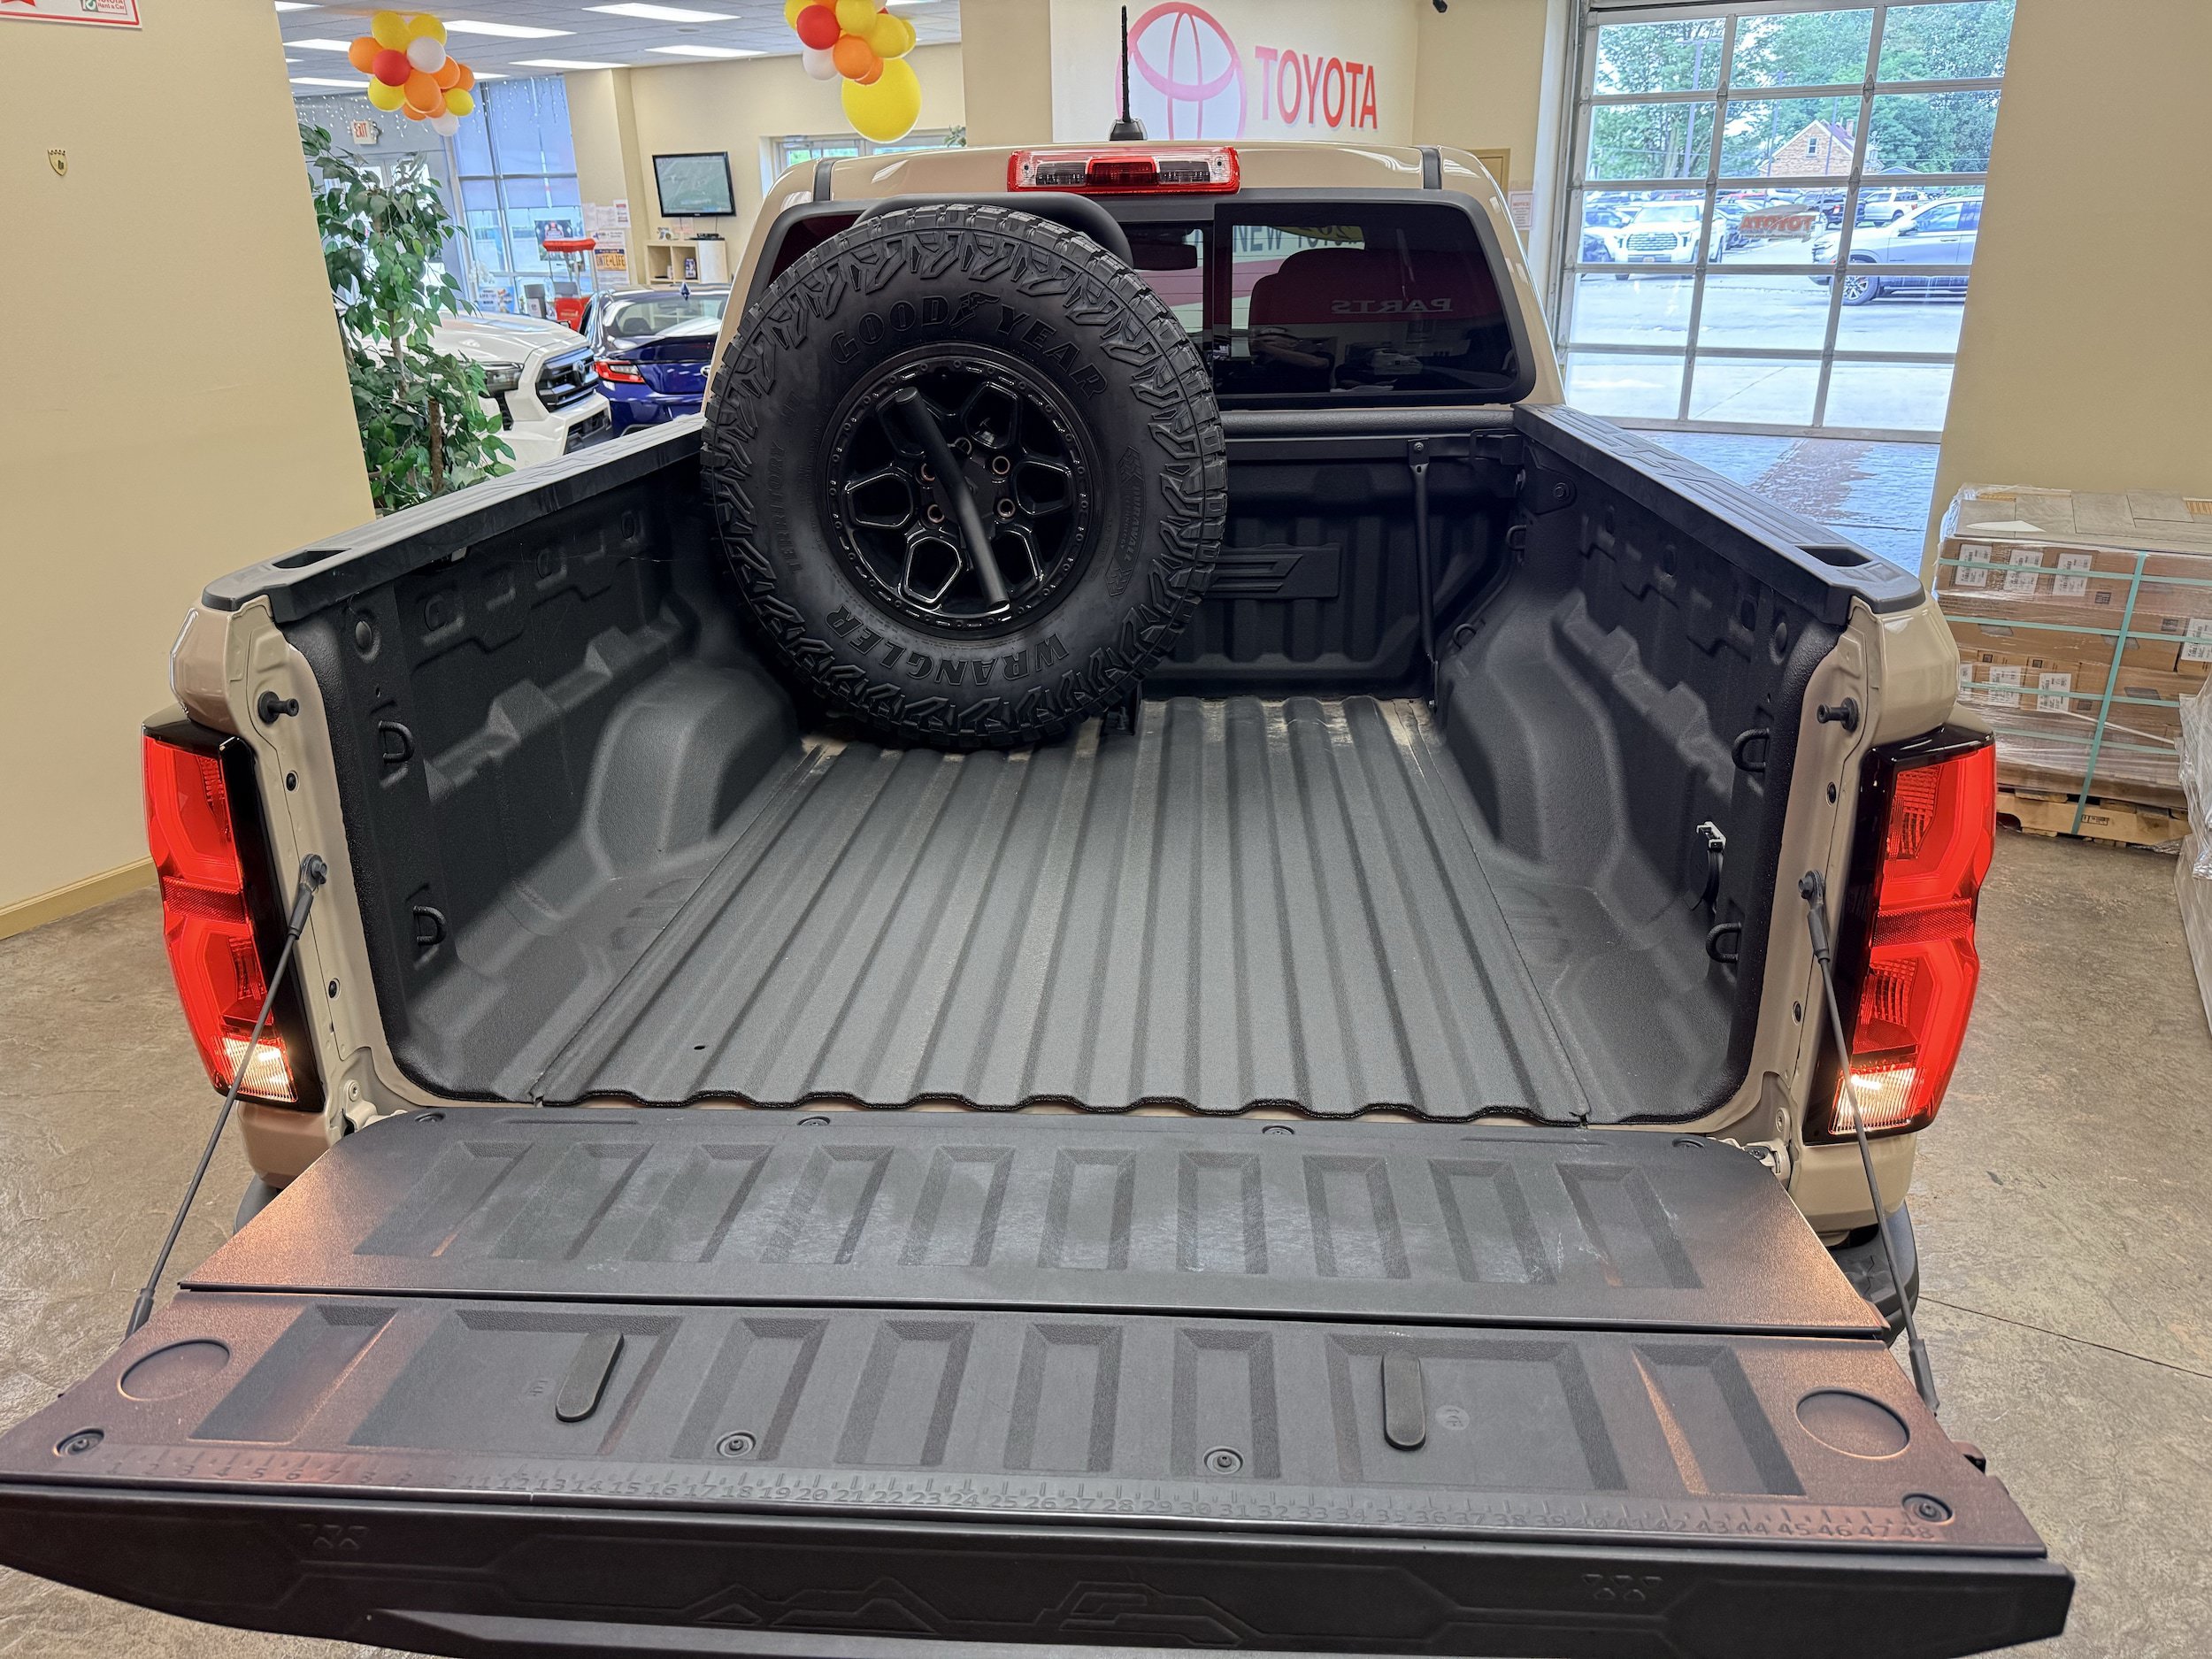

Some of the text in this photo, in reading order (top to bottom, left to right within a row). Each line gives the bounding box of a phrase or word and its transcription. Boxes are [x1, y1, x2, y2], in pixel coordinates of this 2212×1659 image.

[1255, 46, 1378, 129] TOYOTA
[354, 122, 368, 137] EXIT
[828, 295, 1108, 398] GOOD YEAR
[767, 440, 803, 574] TERRITORY
[825, 604, 1071, 687] WRANGLER
[177, 1464, 196, 1478] 3
[214, 1466, 232, 1479] 4
[248, 1467, 268, 1479] 5
[285, 1469, 303, 1481] 6
[323, 1470, 342, 1482] 7
[534, 1479, 567, 1492] 13
[571, 1479, 603, 1493] 14
[609, 1481, 641, 1494] 15
[645, 1483, 680, 1495] 16
[683, 1484, 718, 1497] 17
[721, 1485, 754, 1498] 18
[758, 1486, 792, 1500] 19
[795, 1487, 828, 1502] 20
[833, 1488, 864, 1502] 21
[870, 1490, 903, 1504] 22
[909, 1491, 941, 1505] 23
[948, 1493, 979, 1507] 24
[988, 1494, 1018, 1508] 25
[1024, 1495, 1057, 1509] 26
[1064, 1496, 1096, 1510] 27
[1102, 1498, 1134, 1512] 28
[1141, 1499, 1172, 1513] 29
[1179, 1501, 1212, 1515] 30
[1219, 1502, 1250, 1517] 31
[1256, 1504, 1288, 1518] 32
[1298, 1506, 1329, 1520] 33
[1336, 1507, 1368, 1522] 34
[1375, 1508, 1407, 1523] 35
[1414, 1509, 1448, 1523] 36
[1454, 1511, 1486, 1525] 37
[1494, 1512, 1528, 1526] 38
[1694, 1519, 1729, 1534] 43
[1735, 1520, 1769, 1535] 44
[1777, 1522, 1812, 1536] 45
[1817, 1524, 1853, 1538] 46
[1858, 1525, 1891, 1539] 47
[1901, 1525, 1935, 1540] 48
